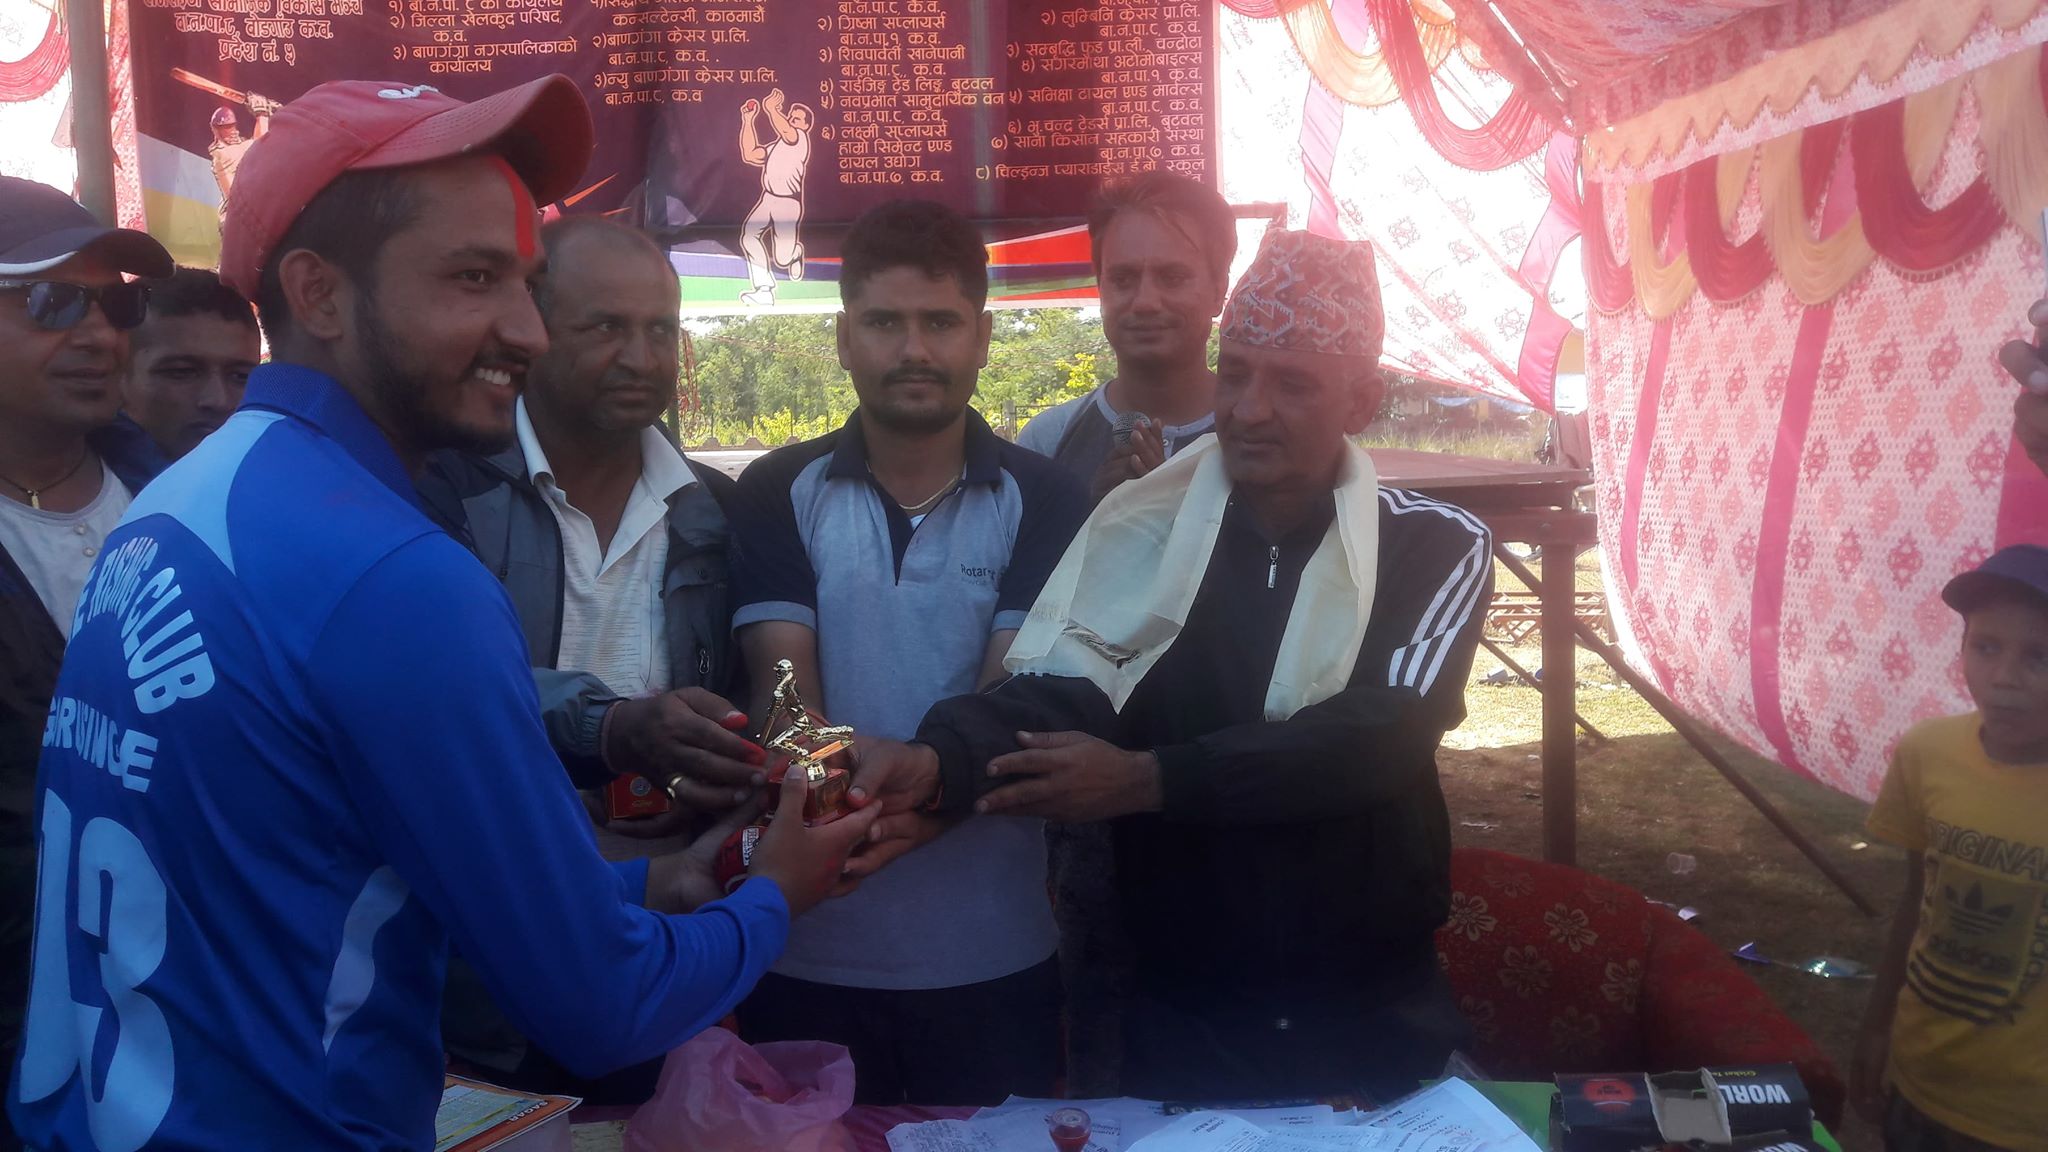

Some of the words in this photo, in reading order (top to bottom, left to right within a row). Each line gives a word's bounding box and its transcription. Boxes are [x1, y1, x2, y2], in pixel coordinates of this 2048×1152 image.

[411, 13, 456, 28] जिल्ला
[461, 10, 515, 29] खेलकुद
[433, 29, 467, 43] क.व.
[982, 93, 1005, 105] वन
[121, 566, 216, 715] CLUB
[1723, 1084, 1791, 1105] WORL
